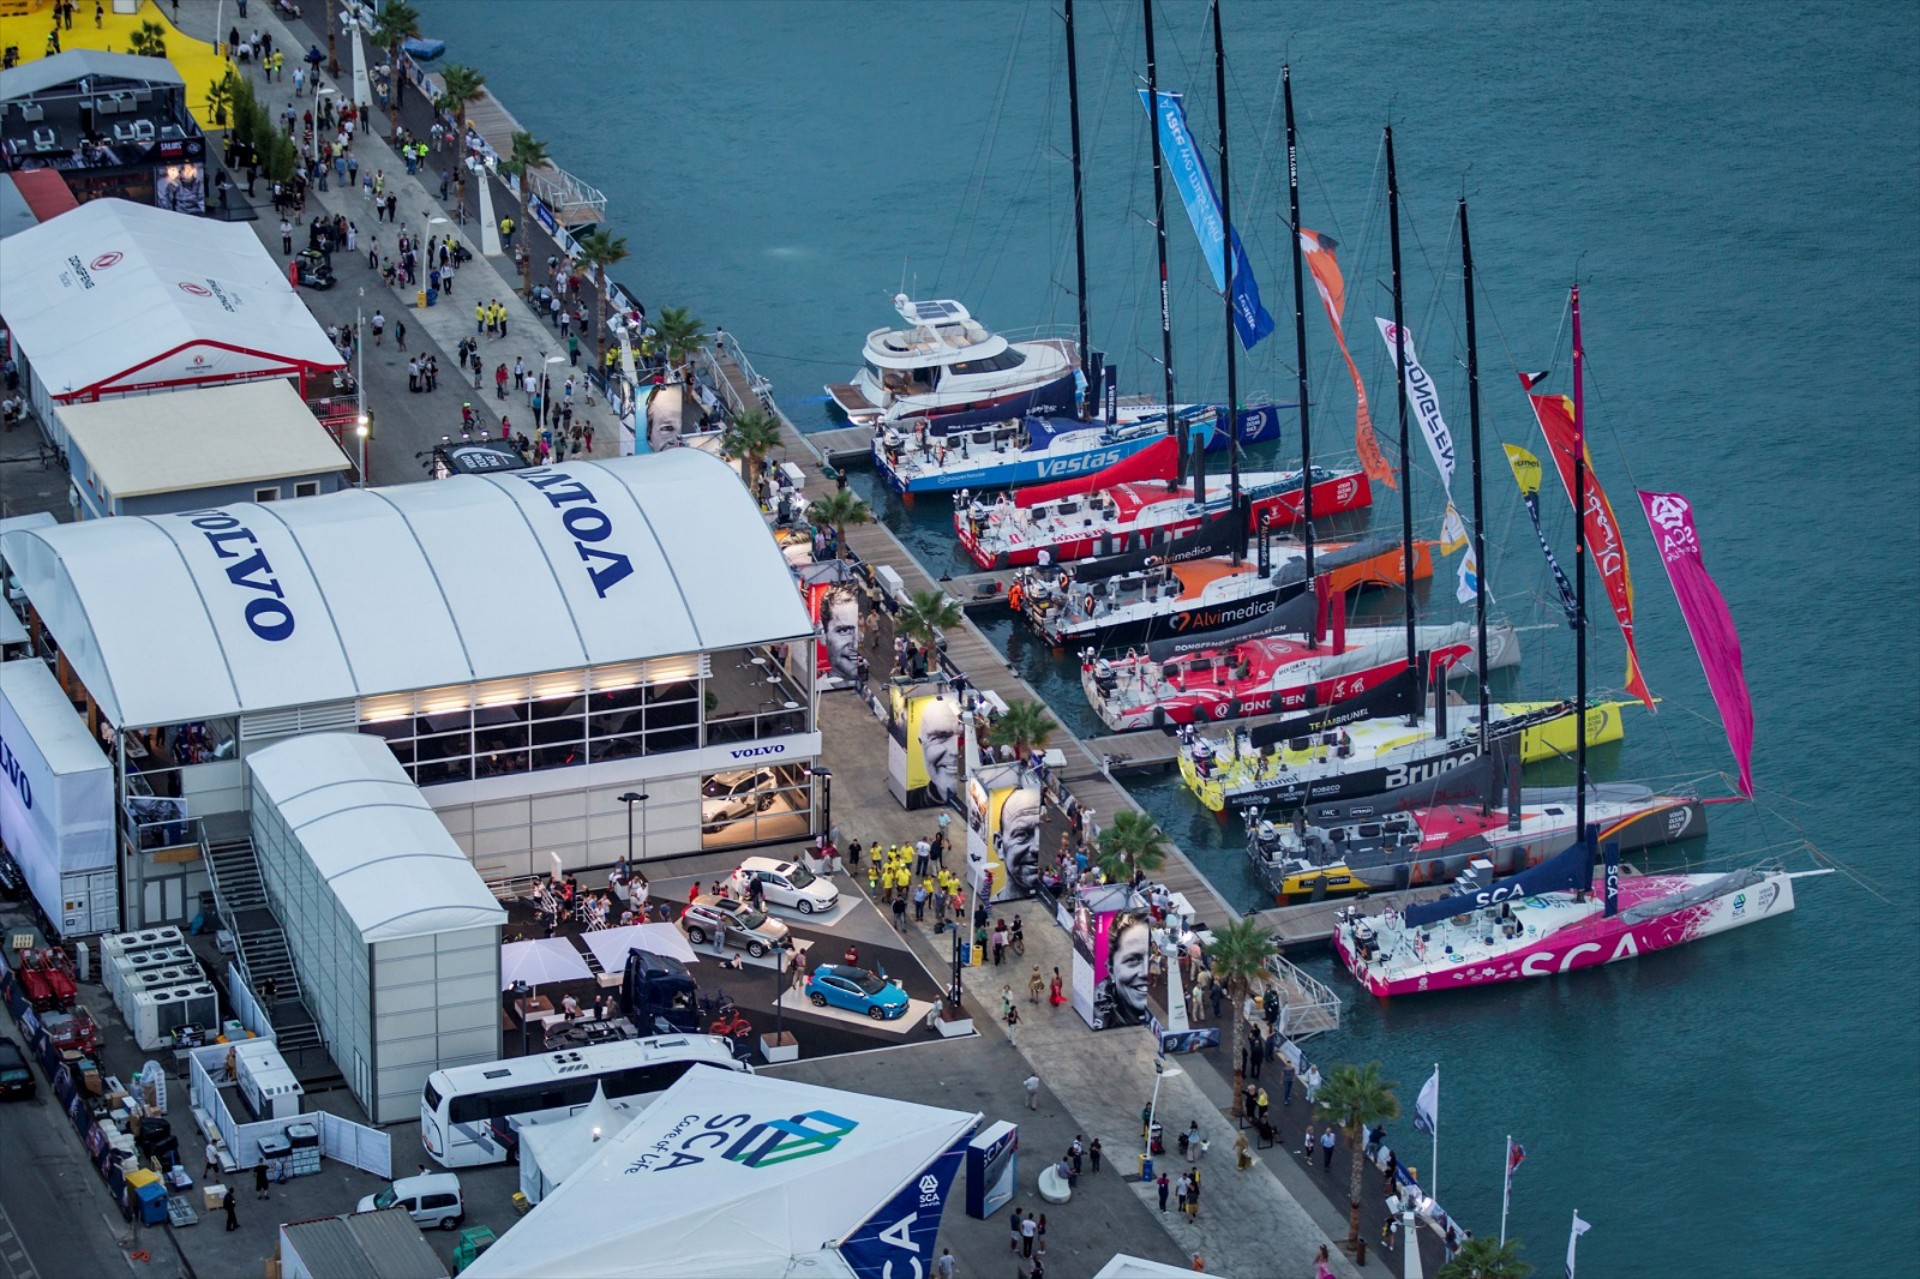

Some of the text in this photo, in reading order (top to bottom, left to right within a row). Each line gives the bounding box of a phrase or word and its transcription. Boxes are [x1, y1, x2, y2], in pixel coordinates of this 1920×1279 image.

[946, 472, 986, 483] powerhouse
[1037, 449, 1121, 478] Vestas
[1158, 545, 1212, 564] Alvimedica
[175, 509, 295, 642] VOLVO
[1192, 600, 1276, 629] Alvimedica
[730, 744, 785, 759] VOLVO
[1385, 743, 1482, 790] Brunel
[1475, 883, 1524, 908] SCA
[1607, 864, 1618, 899] SCA
[1731, 907, 1746, 917] SCA
[1521, 931, 1640, 977] SCA
[653, 1113, 751, 1172] SCA
[919, 1192, 940, 1203] SCA
